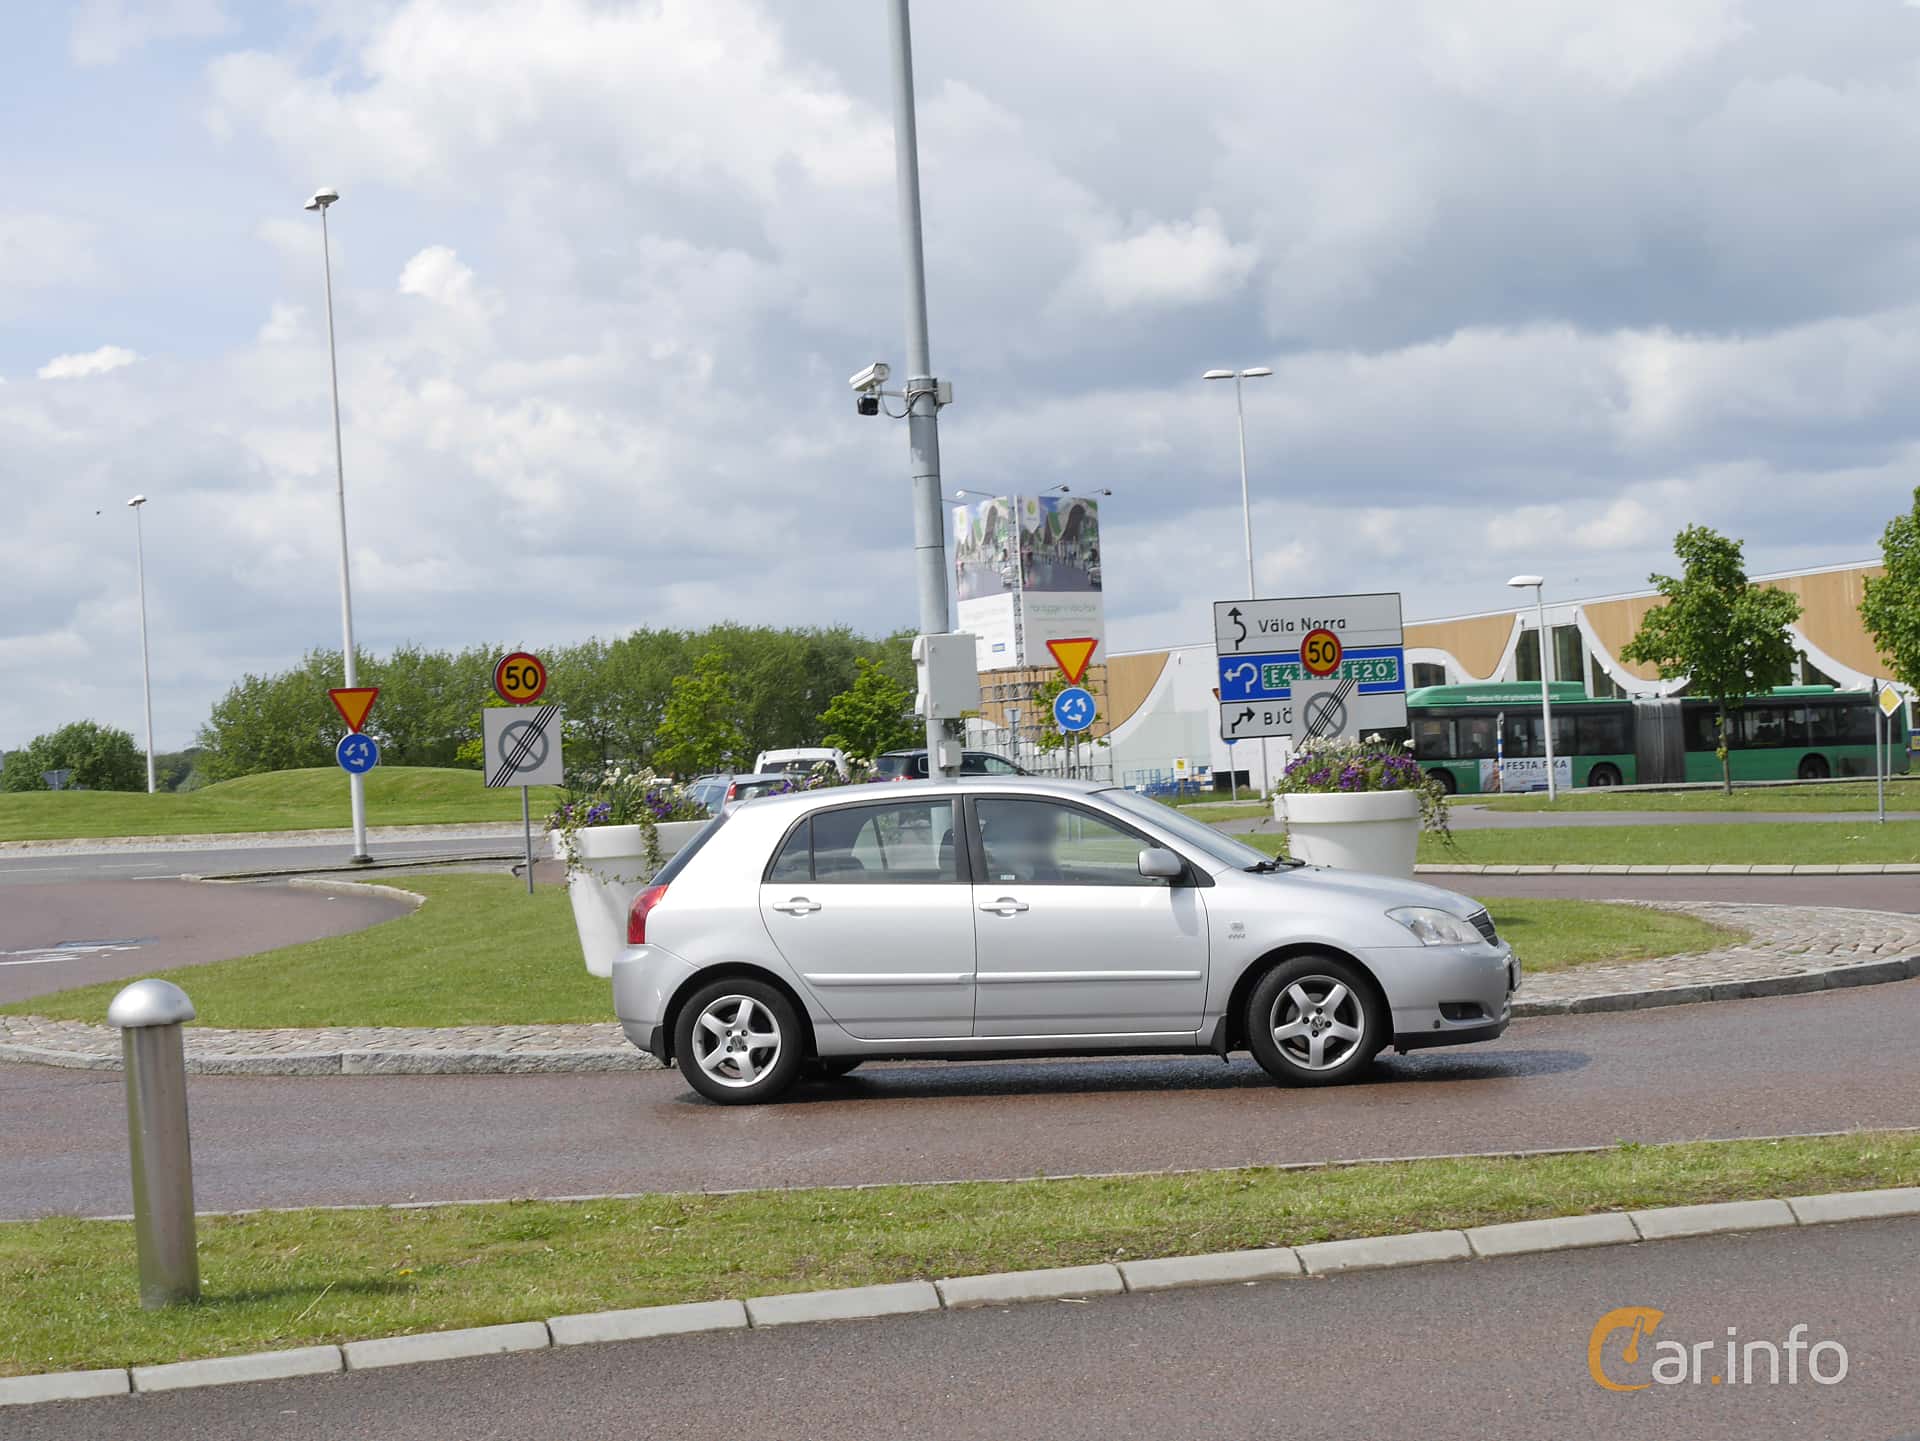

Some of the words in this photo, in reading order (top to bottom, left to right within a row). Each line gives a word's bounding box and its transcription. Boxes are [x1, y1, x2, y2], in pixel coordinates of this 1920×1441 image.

[1258, 618, 1295, 633] Väla
[1301, 616, 1346, 632] Norra
[1308, 640, 1336, 664] 50
[505, 665, 539, 690] 50
[1270, 669, 1293, 684] E4
[1351, 663, 1387, 679] E20
[1542, 760, 1568, 768] FKA
